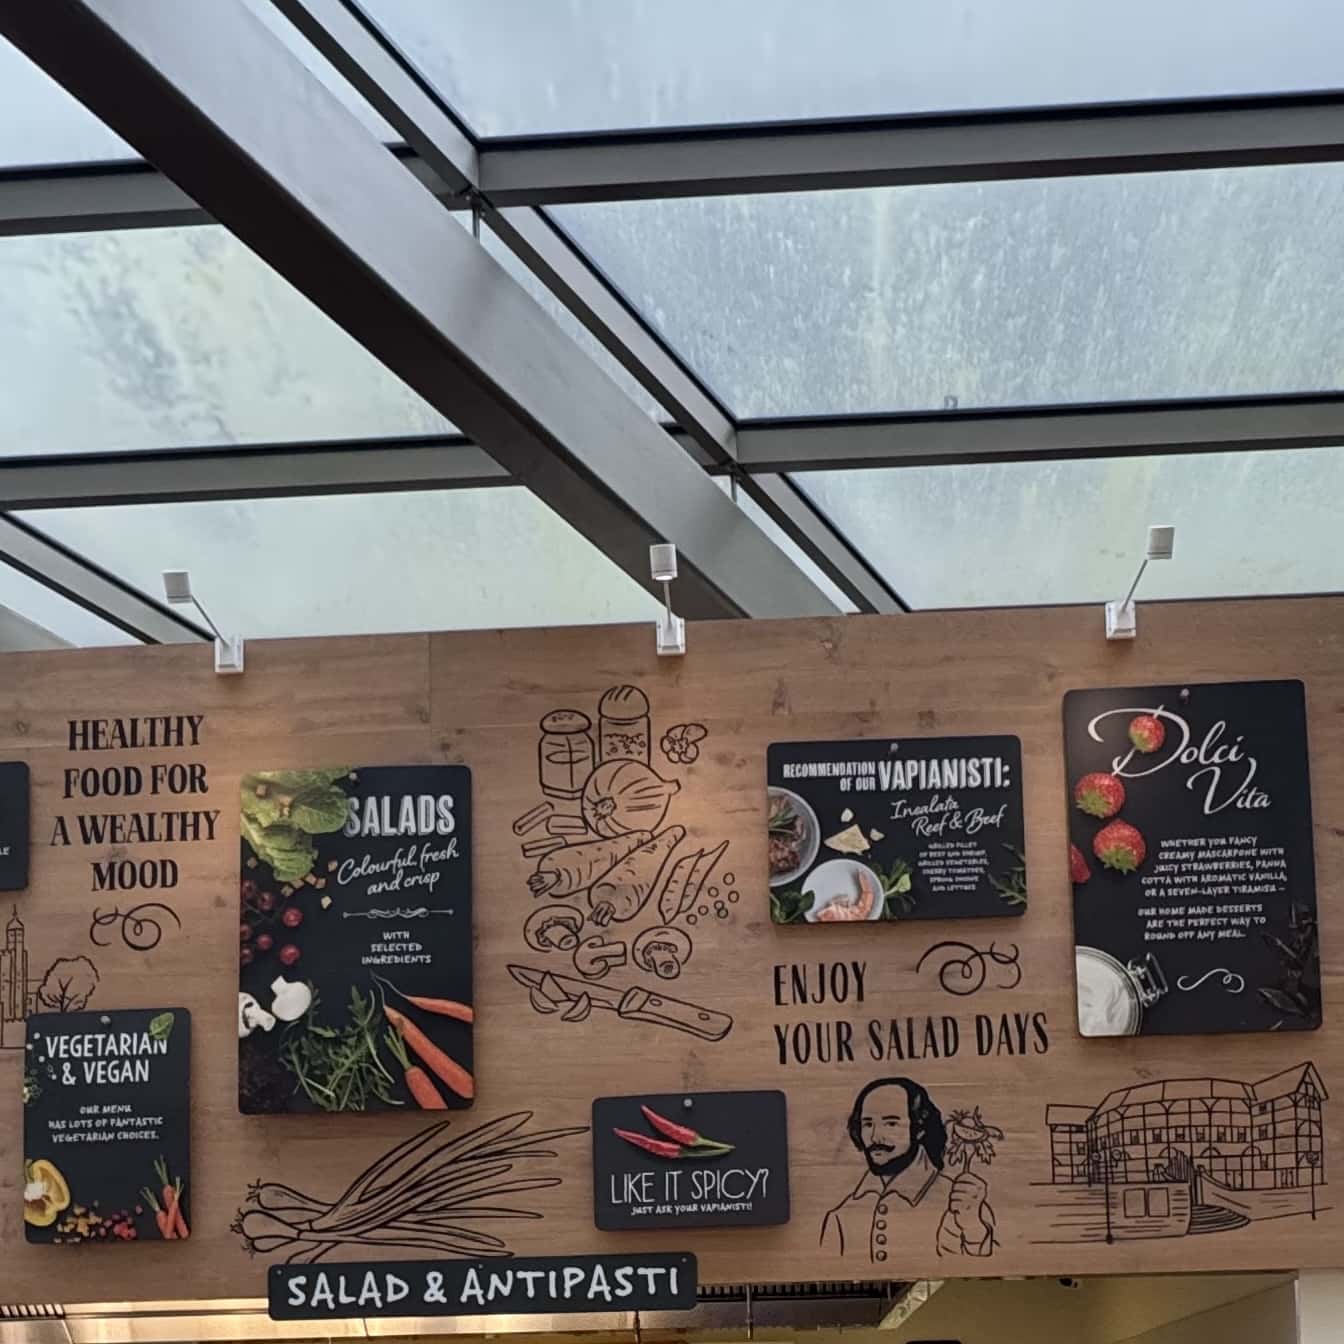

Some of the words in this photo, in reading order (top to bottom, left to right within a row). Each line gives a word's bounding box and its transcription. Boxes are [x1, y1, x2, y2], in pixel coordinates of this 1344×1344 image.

[68, 715, 204, 750] HEALTHY
[1087, 704, 1244, 778] Dolci
[63, 766, 142, 798] FOOD
[150, 763, 208, 795] FOR
[783, 761, 876, 778] RECOMMENDATION
[878, 757, 1010, 791] VAPIANISTI:
[839, 778, 852, 791] OF
[855, 777, 876, 791] OUR
[1186, 757, 1272, 815] Vita
[50, 816, 72, 846] A
[76, 810, 221, 845] WEALTHY
[344, 794, 455, 837] SALADS
[911, 818, 947, 836] Reef
[948, 812, 964, 830] &
[964, 804, 1007, 834] Beef
[420, 837, 459, 872] fresh
[1158, 850, 1195, 861] CREAMY
[1197, 848, 1256, 859] MASCARPONE
[1259, 848, 1284, 856] WITH
[1160, 838, 1206, 848] WHETHER
[1208, 837, 1226, 848] YOU
[1229, 836, 1258, 848] FANCY
[90, 858, 178, 892] MOOD
[1141, 876, 1172, 885] COTTA
[1174, 875, 1198, 883] WITH
[1201, 873, 1247, 883] AROMATIC
[1154, 863, 1179, 874] JUICY
[1181, 860, 1254, 872] STRAWBERRIES,
[1256, 859, 1287, 869] PANNA
[367, 870, 404, 895] and
[404, 871, 440, 893] crisp
[1144, 888, 1157, 897] OR
[1159, 887, 1165, 897] A
[1232, 884, 1277, 894] TIRAMISU
[1137, 907, 1156, 916] OUR
[1158, 907, 1185, 916] HOME
[1188, 905, 1214, 914] MADE
[1216, 904, 1262, 914] DESSERTS
[1146, 919, 1163, 928] ARE
[1166, 918, 1184, 927] THE
[1187, 917, 1227, 927] PERFECT
[1230, 917, 1250, 927] WAY
[1253, 916, 1266, 924] TO
[371, 942, 423, 952] SELECTED
[383, 931, 410, 940] WITH
[1144, 931, 1175, 940] ROUND
[1178, 931, 1194, 939] OFF
[1197, 930, 1215, 940] ANY
[362, 955, 432, 965] INGREDIENTS
[773, 961, 866, 1006] ENJOY
[46, 1032, 168, 1058] VEGETARIAN
[773, 1021, 854, 1065] YOUR
[868, 1016, 959, 1061] SALAD
[975, 1012, 1049, 1056] DAYS
[62, 1062, 76, 1085] &
[83, 1059, 150, 1084] VEGAN
[80, 1105, 99, 1114] OUR
[102, 1104, 132, 1114] MENU
[48, 1120, 66, 1129] HAS
[69, 1119, 93, 1128] LOTS
[95, 1119, 107, 1128] OF
[110, 1116, 163, 1127] FANTASTIC
[52, 1132, 115, 1143] VEGETARIAN
[611, 1172, 655, 1203] LIKE
[665, 1170, 683, 1201] IT
[691, 1168, 769, 1200] SPICY?
[631, 1206, 654, 1216] JUST
[656, 1204, 673, 1214] ASK
[675, 1204, 698, 1215] YOUR
[287, 1270, 409, 1309] SALAD
[423, 1270, 447, 1303] &
[460, 1264, 678, 1305] ANTIPASTI
